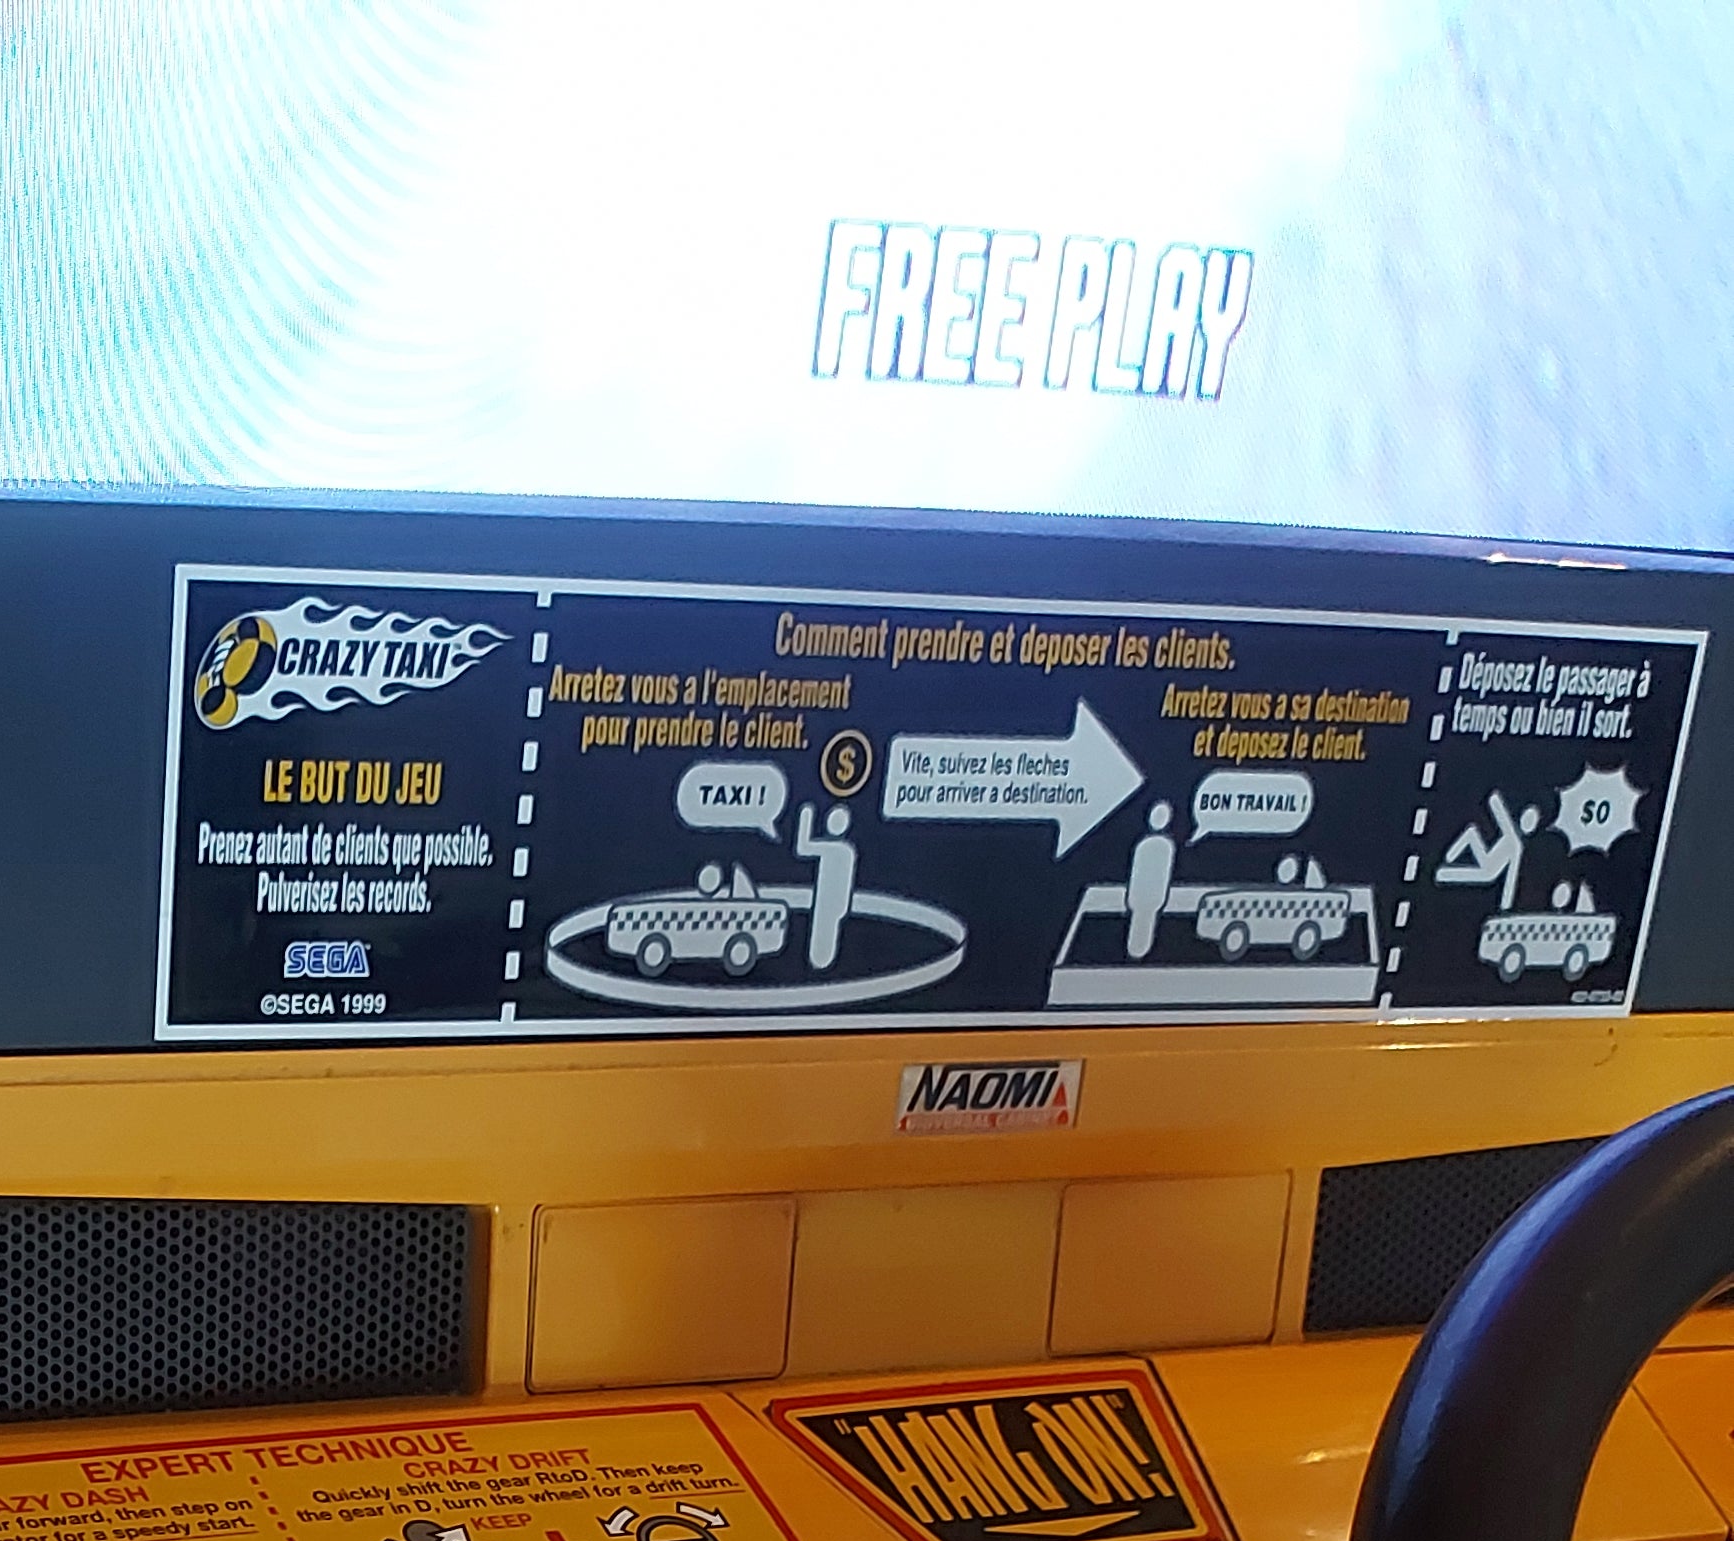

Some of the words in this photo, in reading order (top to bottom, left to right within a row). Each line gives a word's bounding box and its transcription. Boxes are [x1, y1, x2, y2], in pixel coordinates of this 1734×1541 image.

[811, 218, 1041, 389] FREE
[1042, 234, 1256, 402] PLAY
[277, 637, 379, 677] CRAZY
[381, 641, 452, 679] TAXI
[774, 610, 889, 660] Comment
[891, 620, 984, 670] prendre
[988, 623, 1016, 665] et
[1019, 623, 1112, 674] deposer
[1114, 627, 1149, 668] les
[1153, 627, 1236, 671] clients.
[548, 663, 627, 704] Arretez
[631, 673, 680, 706] vous
[682, 675, 698, 706] a
[700, 667, 853, 715] l'emplacement
[1458, 651, 1536, 699] Déposez
[1535, 655, 1556, 693] le
[1549, 664, 1638, 708] passager
[1160, 682, 1230, 718] Arretez
[1230, 690, 1272, 720] vous
[1273, 692, 1287, 720] a
[1289, 693, 1312, 721] sa
[1314, 688, 1411, 724] destination
[1451, 695, 1509, 742] temps
[1509, 705, 1535, 735] ou
[1535, 697, 1577, 737] bien
[1576, 700, 1595, 737] il
[1592, 703, 1634, 739] sort.
[581, 714, 632, 755] pour
[633, 709, 715, 755] prendre
[719, 710, 739, 749] le
[743, 711, 810, 750] client.
[1193, 724, 1215, 758] et
[1215, 724, 1291, 766] deposez
[1290, 725, 1310, 760] le
[1311, 725, 1367, 761] client.
[263, 759, 294, 803] LE
[299, 760, 351, 804] BUT
[354, 761, 391, 805] DU
[395, 762, 443, 805] JEU
[901, 748, 935, 778] Vite,
[937, 751, 987, 775] suivez
[990, 751, 1013, 776] les
[1015, 751, 1071, 777] fleches
[698, 785, 753, 807] TAXI
[895, 783, 934, 808] pour
[935, 780, 987, 804] arriver
[989, 786, 1000, 804] a
[1002, 780, 1089, 805] destination.
[1199, 793, 1232, 812] BON
[1236, 793, 1298, 812] TRAVAIL
[197, 821, 255, 865] Prenez
[255, 823, 309, 865] autant
[311, 822, 333, 865] de
[334, 823, 390, 867] clients
[392, 832, 423, 876] que
[256, 871, 339, 913] Pulverisez
[340, 871, 366, 913] les
[367, 871, 432, 913] records.
[284, 940, 370, 979] SEGA
[340, 993, 387, 1015] 1999
[906, 1061, 1061, 1112] NAOMI
[79, 1450, 234, 1484] EXPERT
[242, 1431, 475, 1469] TECHNIQUE
[402, 1455, 500, 1480] CRAZY
[508, 1447, 592, 1471] DRIFT
[60, 1485, 151, 1509] DASH
[296, 1508, 334, 1523] the
[337, 1505, 385, 1522] gear
[389, 1501, 412, 1515] in
[414, 1498, 442, 1515] D,
[441, 1496, 488, 1511] turn
[488, 1492, 526, 1507] the
[527, 1484, 592, 1503] wheel
[592, 1483, 623, 1499] for
[626, 1482, 643, 1496] a
[644, 1477, 688, 1495] drift
[687, 1475, 741, 1491] turn.
[311, 1485, 391, 1505] Quickly
[395, 1481, 445, 1497] shift
[445, 1478, 482, 1493] the
[485, 1475, 532, 1492] gear
[595, 1464, 652, 1481] Then
[651, 1462, 705, 1476] keep
[15, 1509, 114, 1530] forward,
[114, 1505, 166, 1521] then
[170, 1502, 220, 1516] step
[224, 1499, 253, 1512] on
[91, 1529, 109, 1541] a
[112, 1521, 192, 1541] speedy
[196, 1515, 256, 1532] start.
[470, 1511, 533, 1531] KEEP
